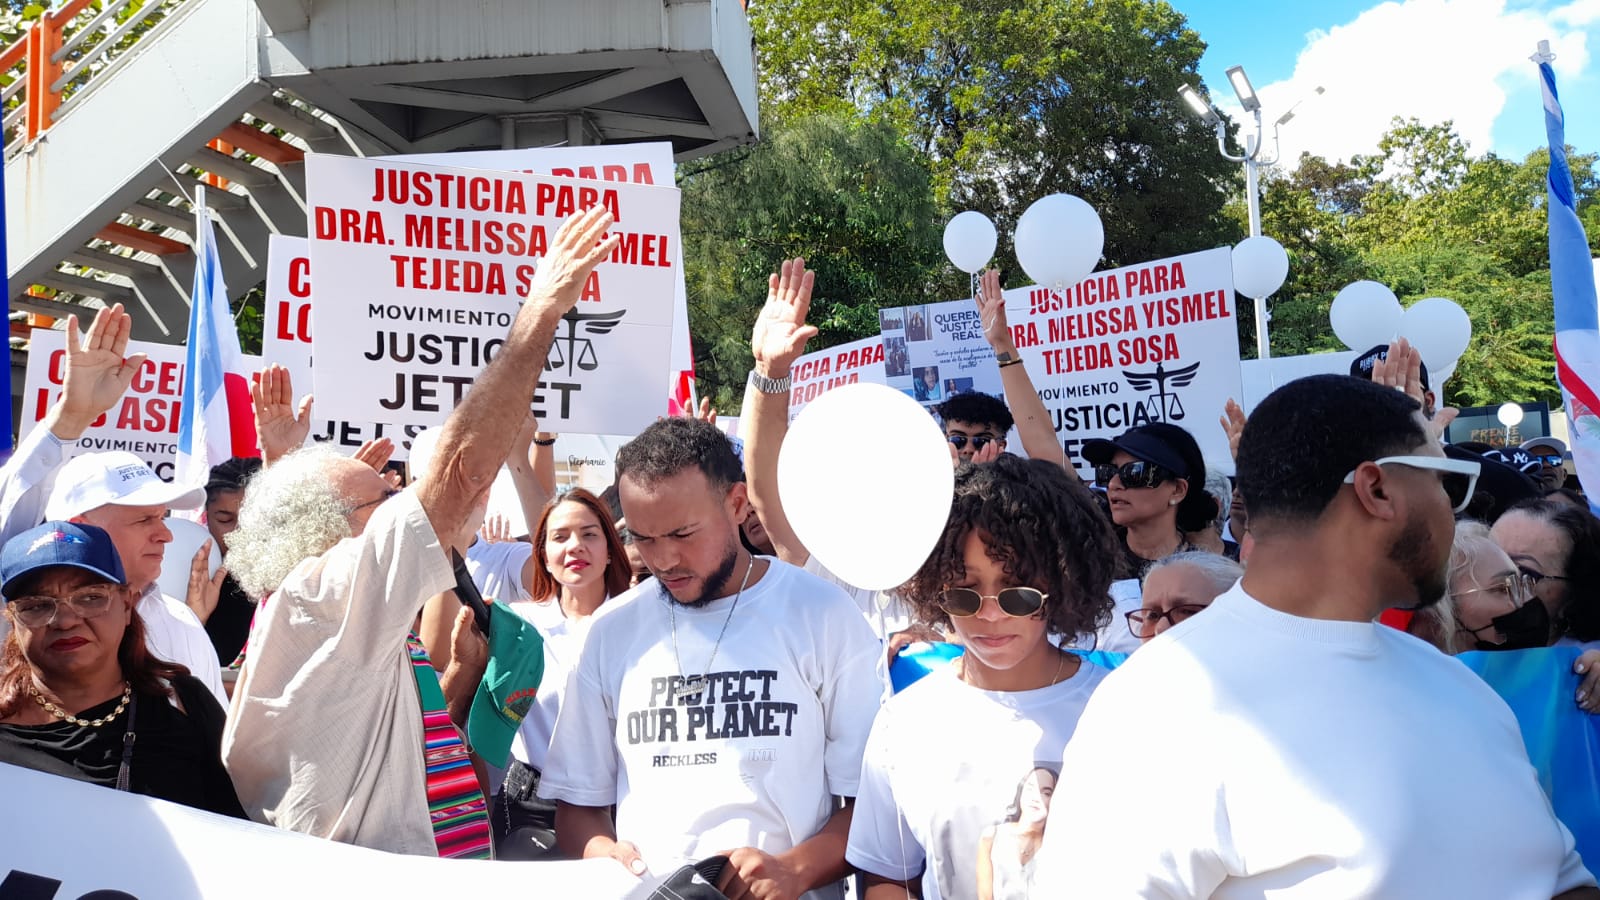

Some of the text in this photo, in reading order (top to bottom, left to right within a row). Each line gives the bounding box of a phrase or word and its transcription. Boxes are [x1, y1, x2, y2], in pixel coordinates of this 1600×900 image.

[372, 167, 526, 214] JUSTICIA
[536, 183, 621, 223] PARA
[315, 206, 394, 246] DRA.
[405, 214, 547, 257] MELISSA
[390, 255, 601, 302] TEJEDA SA
[1125, 261, 1186, 297] PARA
[368, 303, 511, 327] MOVIMIENTO
[934, 310, 982, 325] QUEREM
[1048, 305, 1138, 343] MELISSA
[1142, 289, 1230, 329] YISMEL
[951, 330, 982, 341] REAL
[1042, 333, 1180, 375] TEJEDA SOSA
[48, 349, 184, 396] CCE
[790, 343, 885, 384] ICIA PARA
[379, 372, 581, 419] JET ET
[792, 372, 859, 406] ROLINA
[1048, 401, 1151, 433] USTICIA
[76, 437, 177, 455] OVIMIENTO
[649, 670, 778, 707] PROTECT
[627, 702, 798, 745] OUR PLANET
[652, 752, 717, 768] RECKLESS
